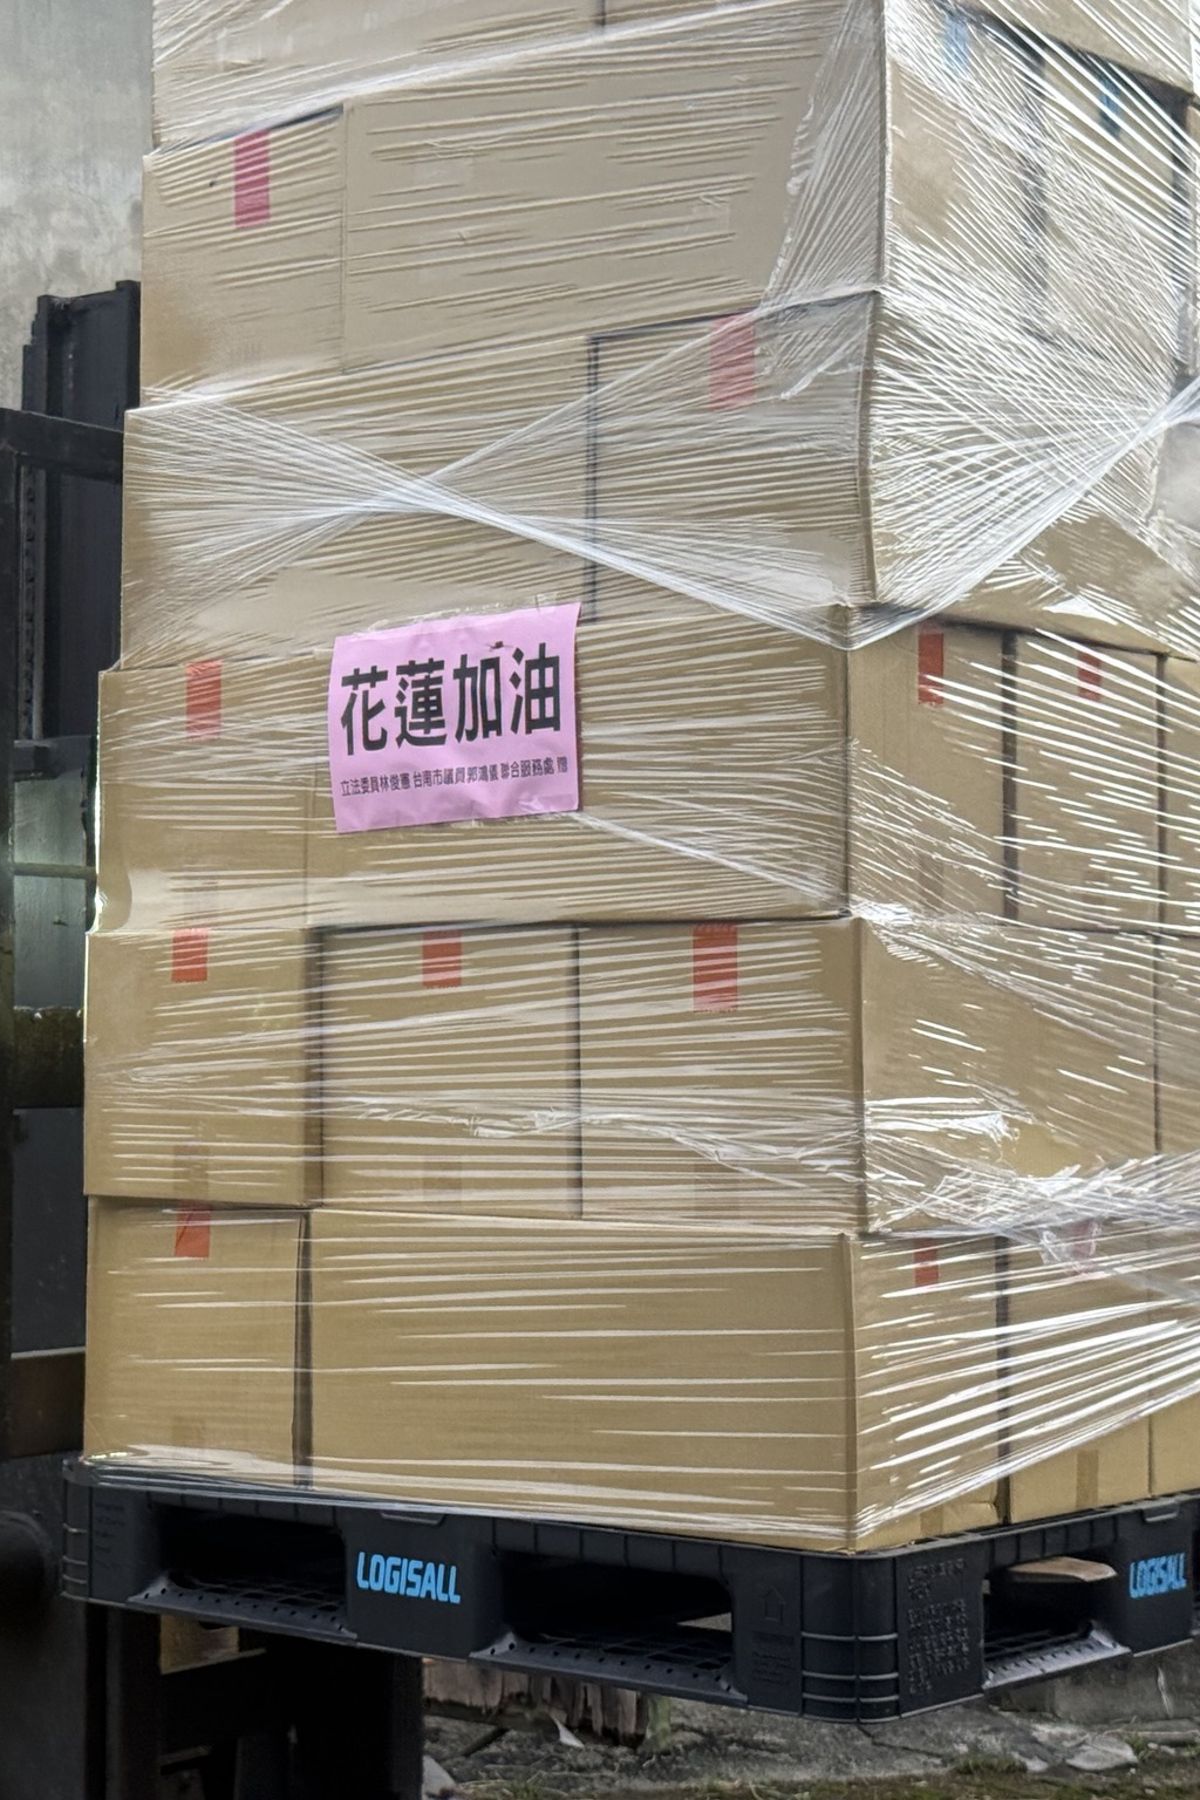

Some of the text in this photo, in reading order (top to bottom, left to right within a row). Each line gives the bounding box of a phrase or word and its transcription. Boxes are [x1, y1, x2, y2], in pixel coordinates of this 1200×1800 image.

[340, 641, 561, 756] 花蓮加油
[356, 1551, 461, 1605] LOGISALL
[1129, 1552, 1187, 1599] LOGISALL
